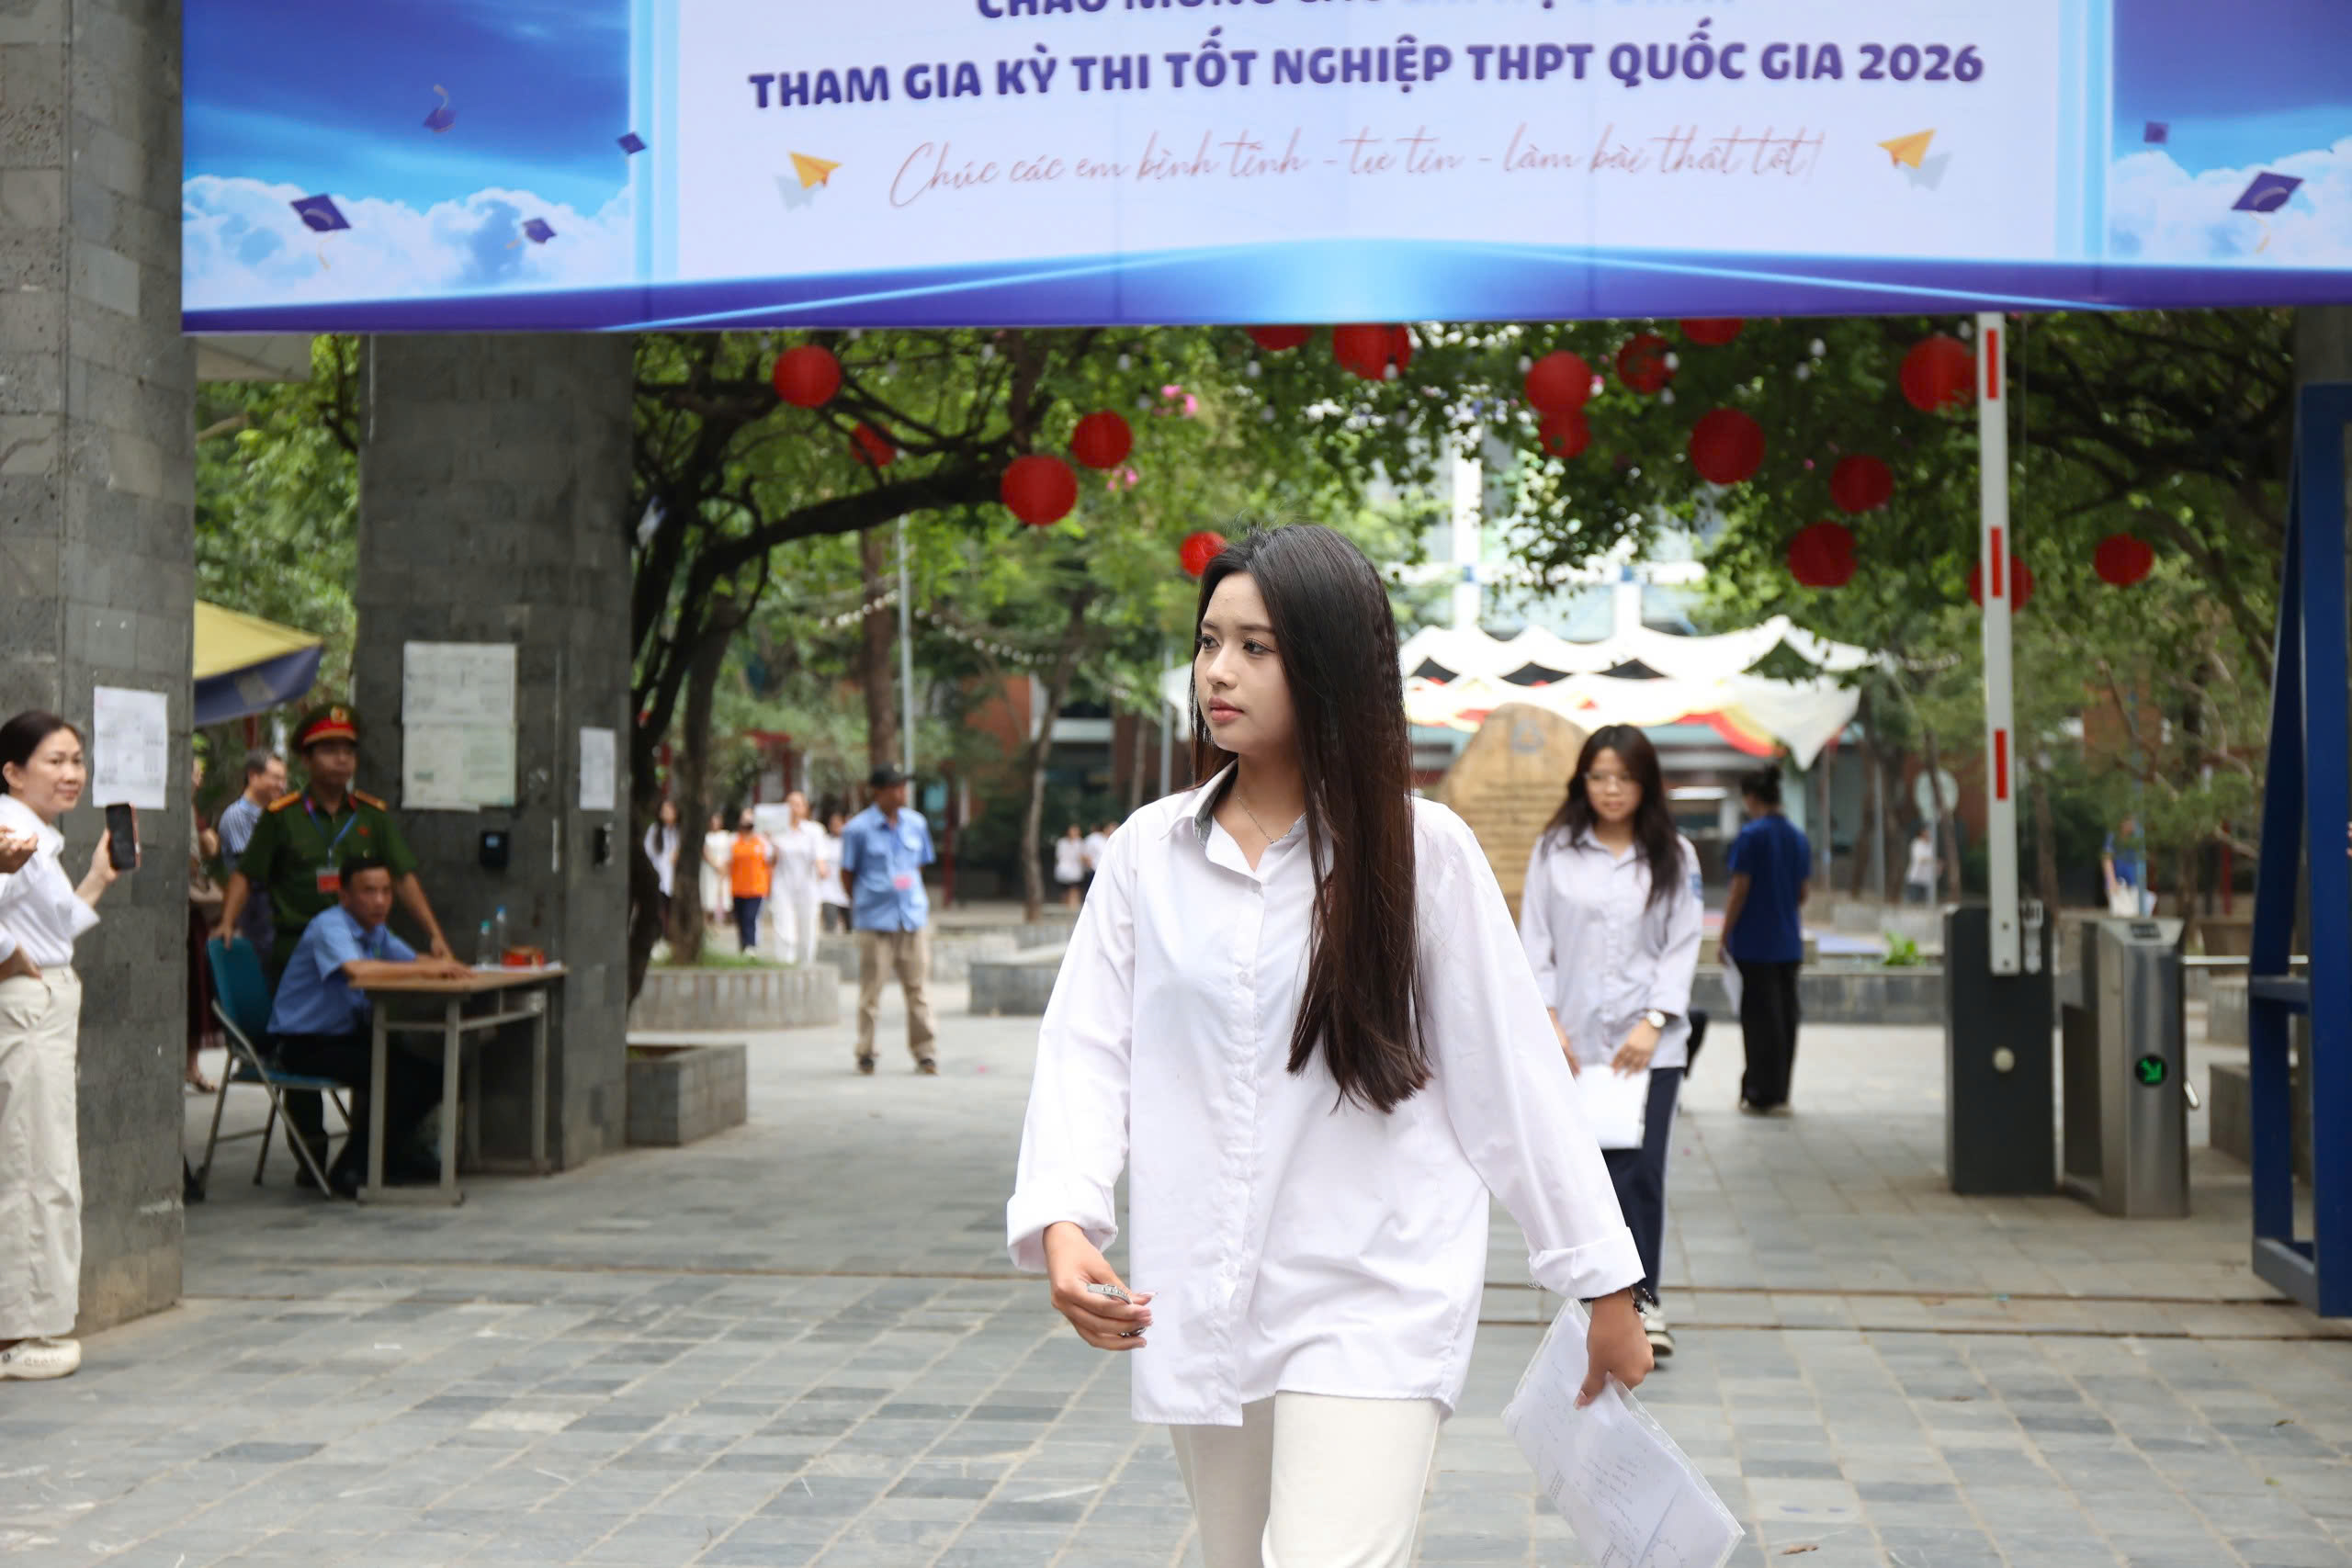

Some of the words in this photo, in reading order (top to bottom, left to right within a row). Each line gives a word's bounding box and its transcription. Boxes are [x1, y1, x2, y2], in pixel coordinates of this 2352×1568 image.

[748, 66, 889, 109] THAM
[903, 62, 982, 100] GIA
[997, 43, 1057, 96] KỲ
[1070, 54, 1149, 92] THI
[1164, 27, 1257, 88] TỐT
[1273, 34, 1452, 94] NGHIỆP
[1466, 43, 1594, 81] THPT
[1609, 17, 1746, 88] QUỐC
[1760, 43, 1843, 80] GIA
[1859, 43, 1984, 83] 2026
[889, 140, 1000, 209] Chúc
[1010, 154, 1066, 182] các
[1076, 157, 1130, 177] em
[1136, 130, 1220, 181] bình
[1396, 125, 1464, 175] tin
[1502, 121, 1581, 173] làm
